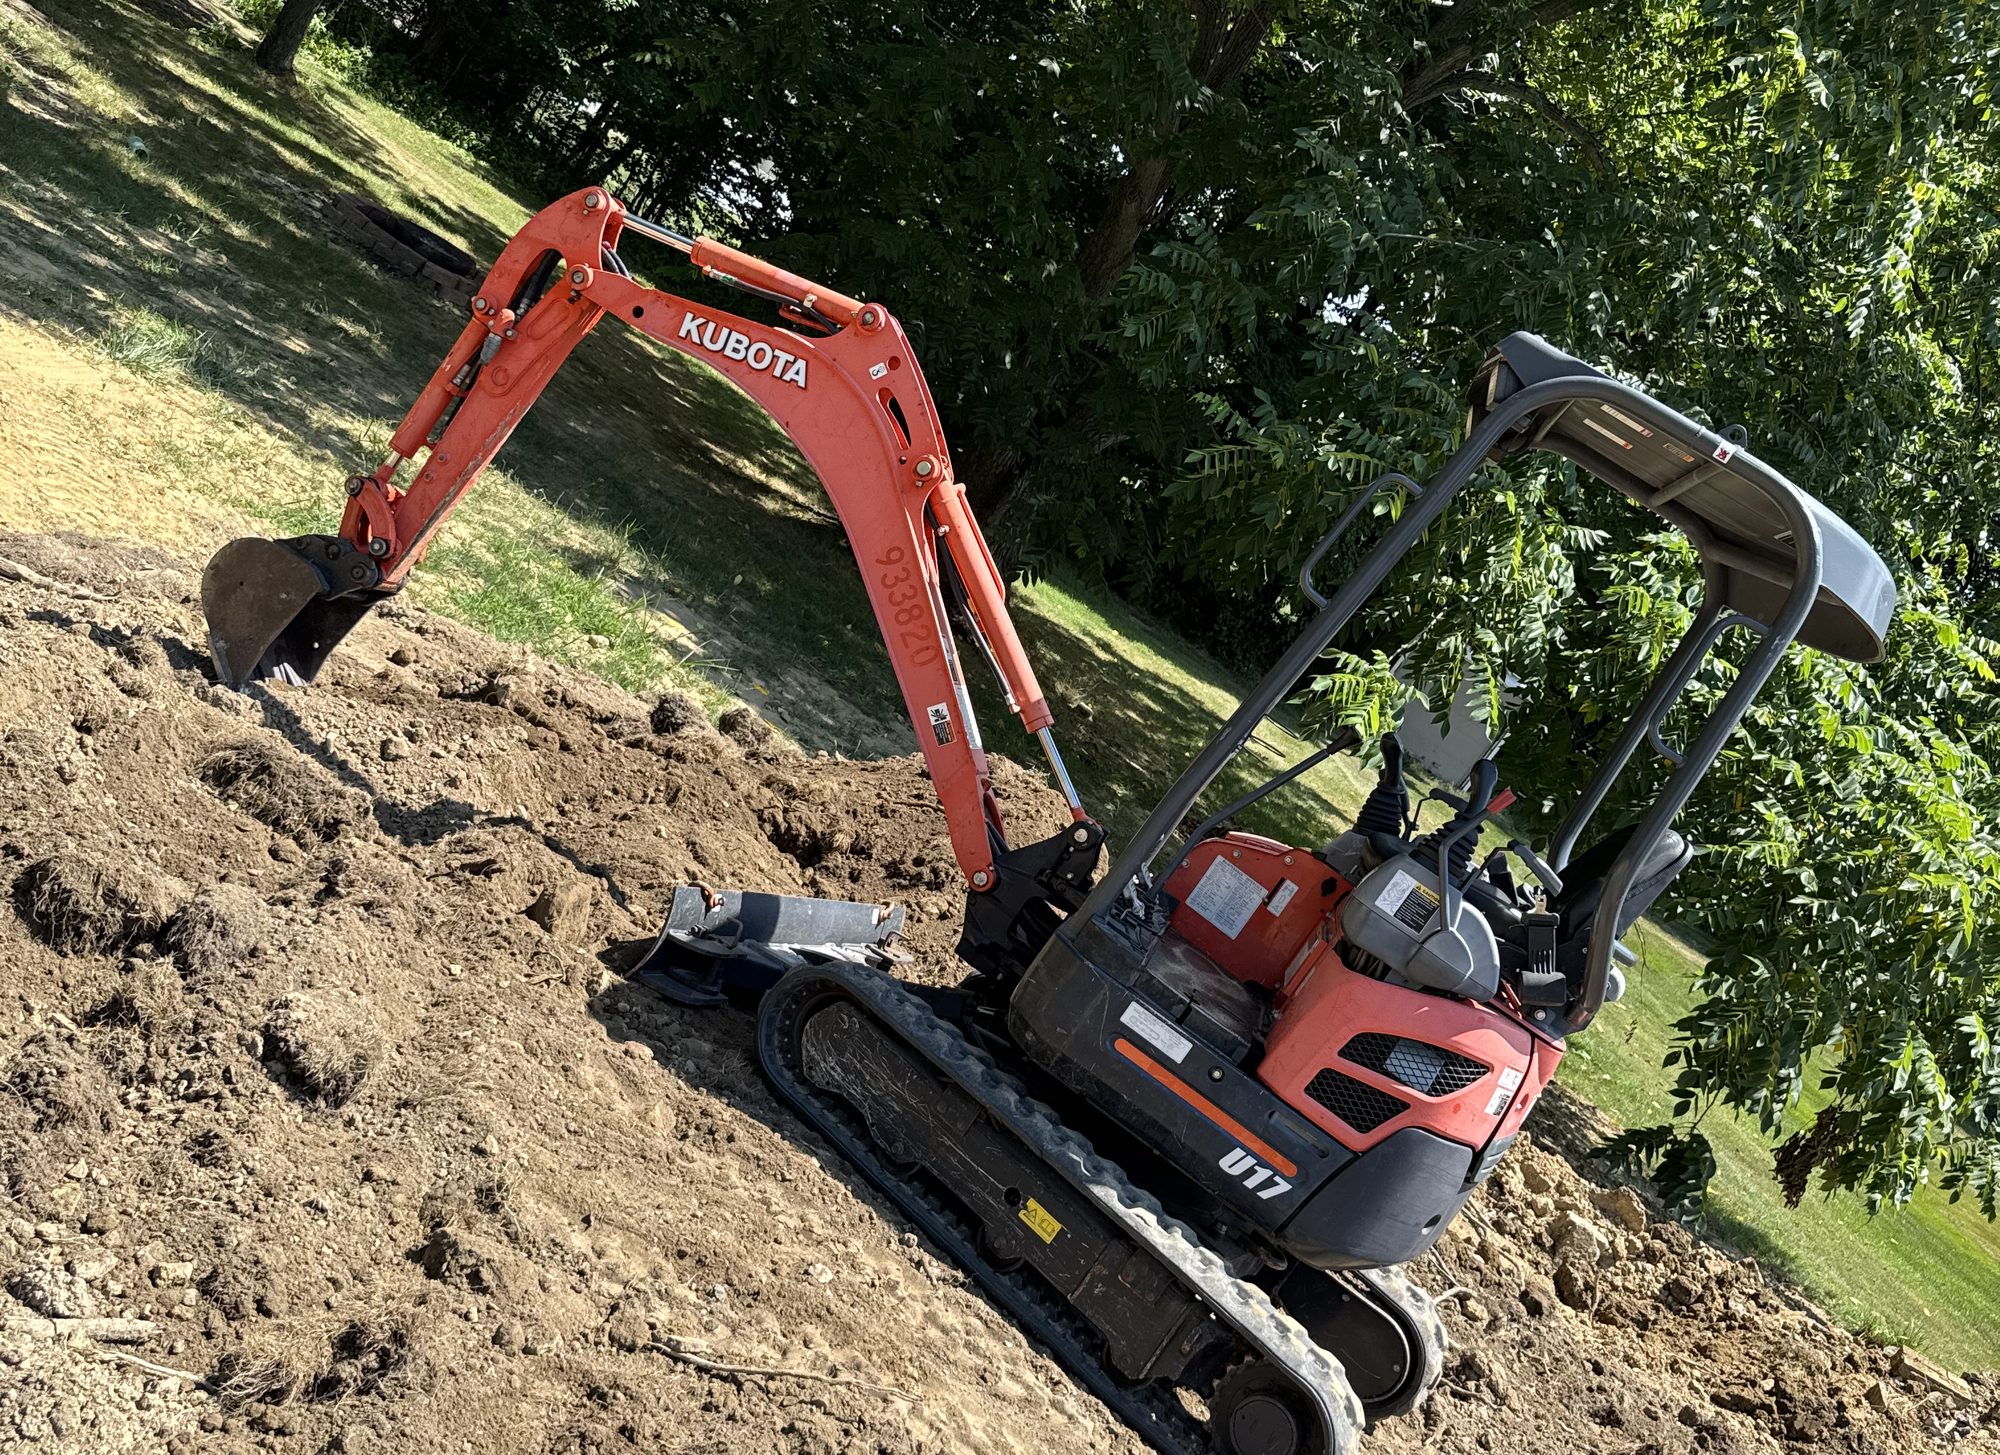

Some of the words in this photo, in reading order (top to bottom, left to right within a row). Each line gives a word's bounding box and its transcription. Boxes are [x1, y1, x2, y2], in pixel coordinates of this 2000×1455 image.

[678, 311, 808, 389] KUBOTA
[875, 546, 938, 667] 933820
[1219, 1147, 1293, 1200] U17
